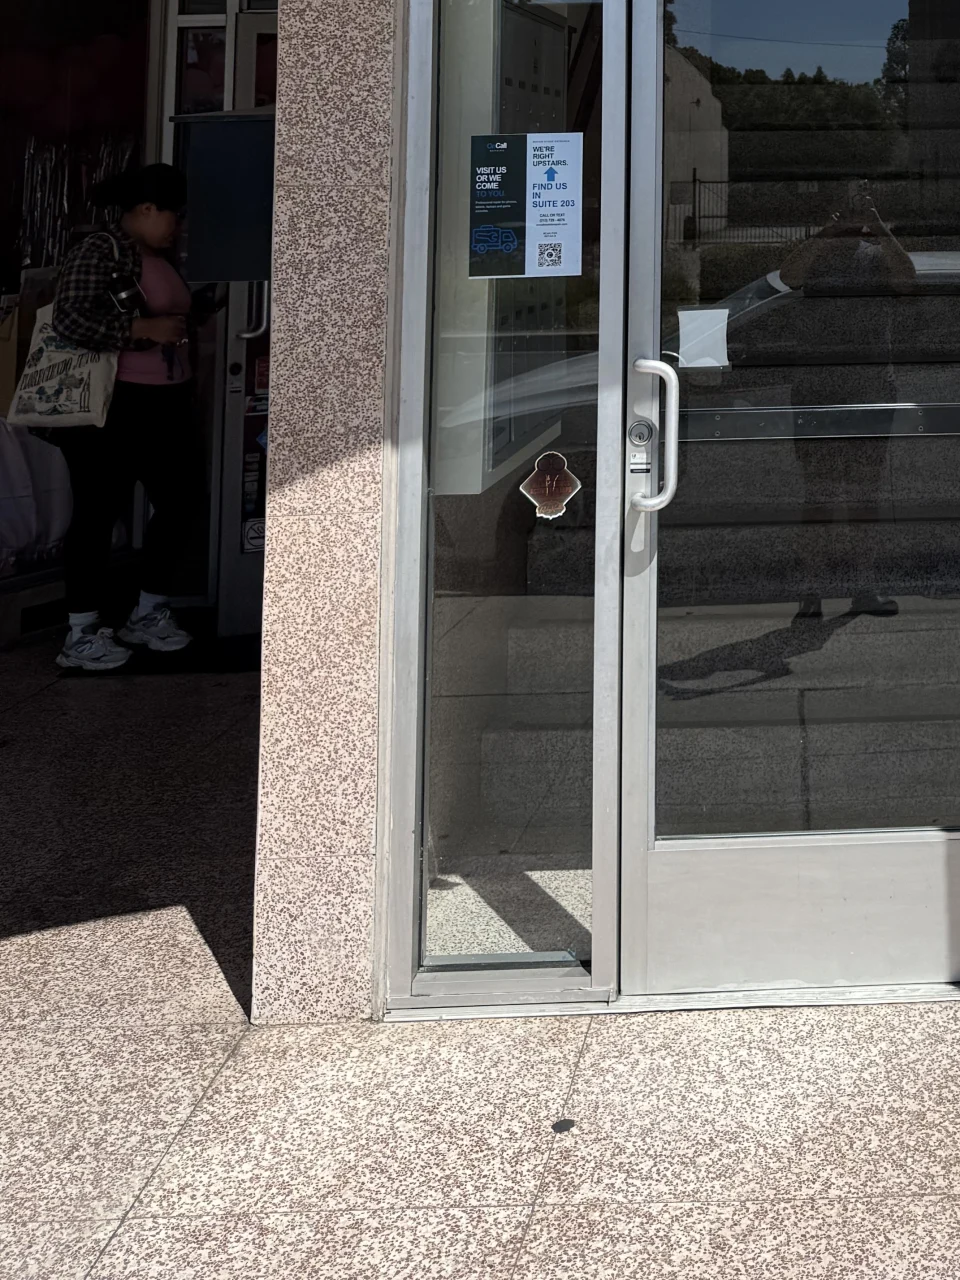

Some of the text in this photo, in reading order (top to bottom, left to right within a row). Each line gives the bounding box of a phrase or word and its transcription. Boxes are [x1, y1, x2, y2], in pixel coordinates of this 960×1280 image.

[555, 182, 568, 190] US
[532, 199, 575, 208] SUITE 203
